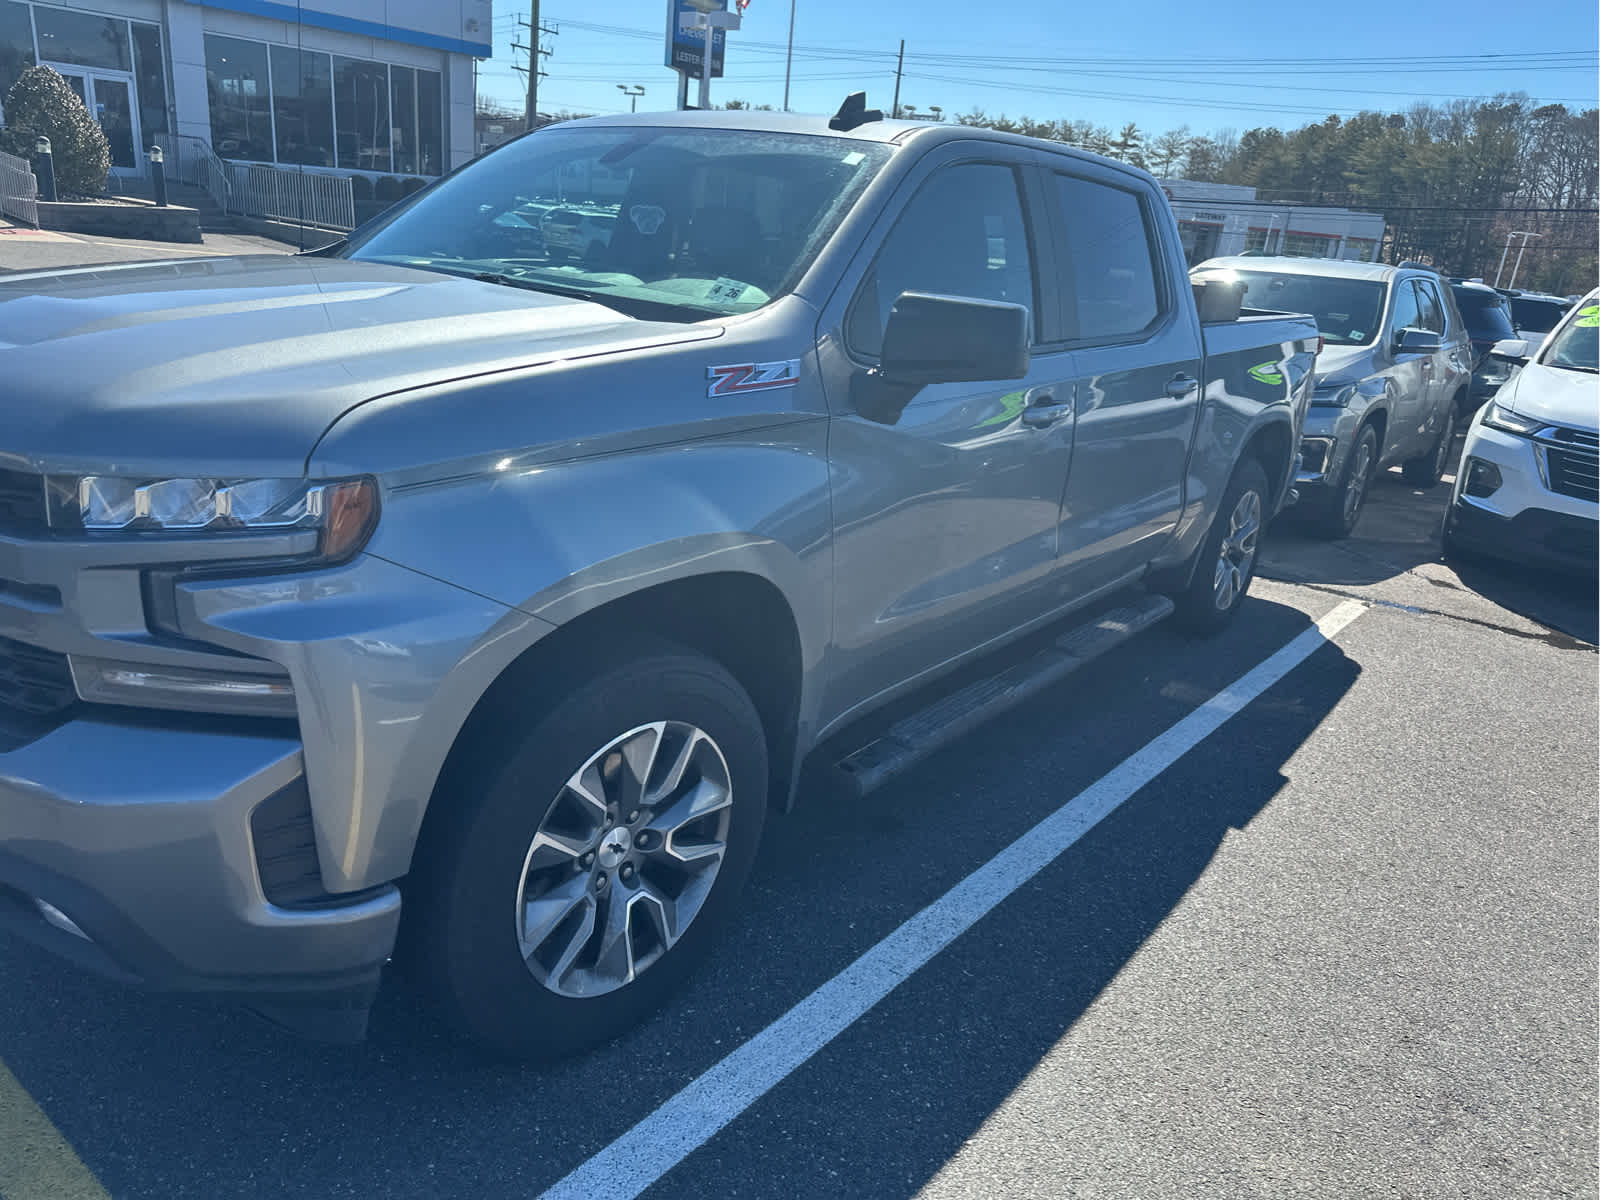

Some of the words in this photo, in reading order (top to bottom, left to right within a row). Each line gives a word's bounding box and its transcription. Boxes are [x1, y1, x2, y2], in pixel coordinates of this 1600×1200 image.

[680, 25, 722, 46] CHEVRET
[676, 51, 700, 65] LESTER
[724, 287, 741, 298] 26
[706, 359, 800, 398] Z71
